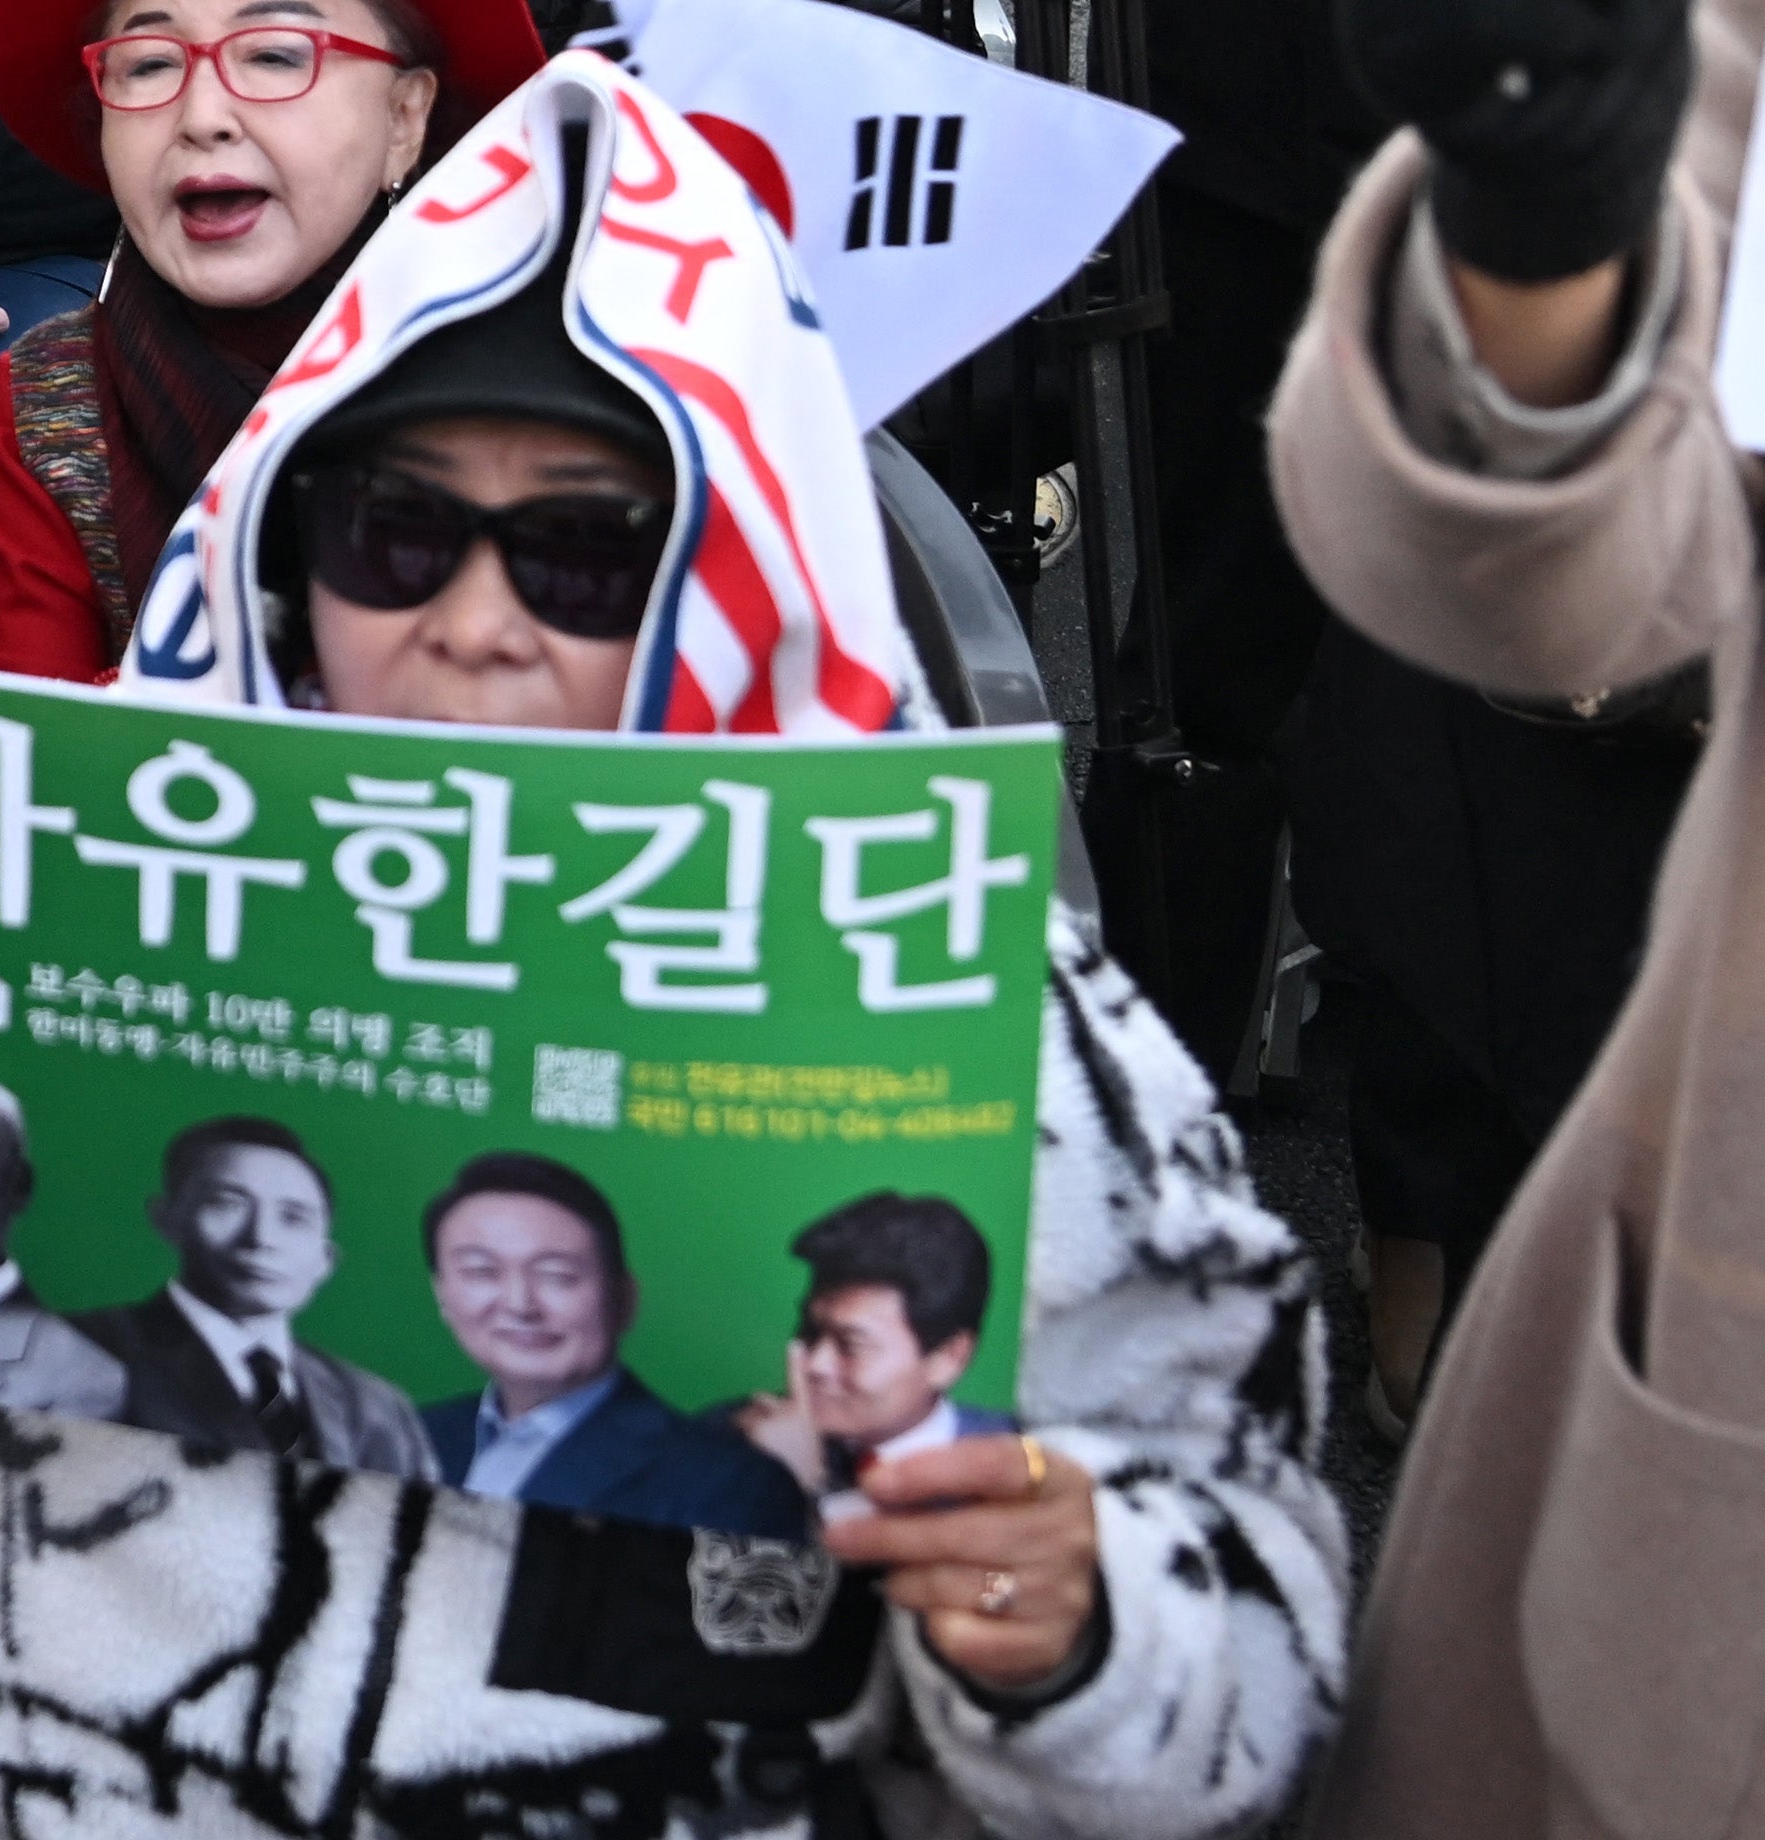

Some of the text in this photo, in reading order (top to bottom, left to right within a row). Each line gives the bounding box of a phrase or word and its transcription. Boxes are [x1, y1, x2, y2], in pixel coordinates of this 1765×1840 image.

[26, 961, 494, 1074] 보수우파 10만 의병 조직
[382, 1065, 492, 1116] 수호단
